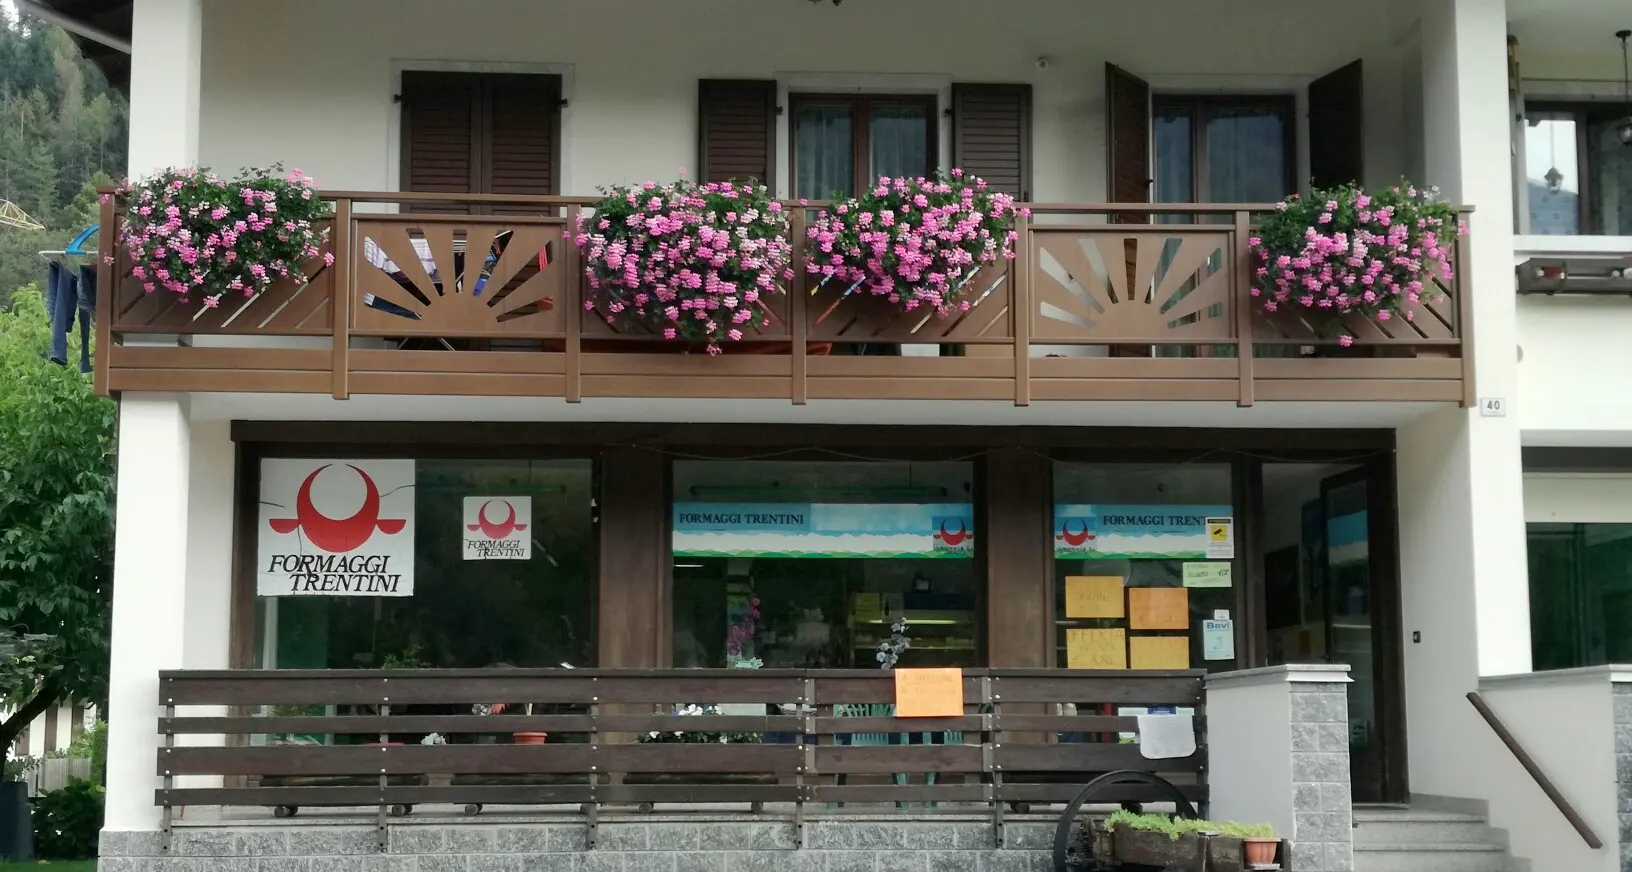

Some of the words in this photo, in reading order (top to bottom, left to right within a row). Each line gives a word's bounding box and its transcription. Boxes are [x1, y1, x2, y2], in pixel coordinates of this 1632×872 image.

[1487, 401, 1500, 410] 40
[679, 513, 742, 525] FORMAGGI
[744, 513, 804, 525] TRENTINI
[1102, 515, 1165, 527] FORMAGGI
[467, 540, 521, 549] FORMAGGI
[476, 548, 526, 558] TRENTINI
[267, 554, 391, 574] FORMAGGI
[288, 574, 402, 593] TRENTINI
[1206, 621, 1231, 629] Bevi
